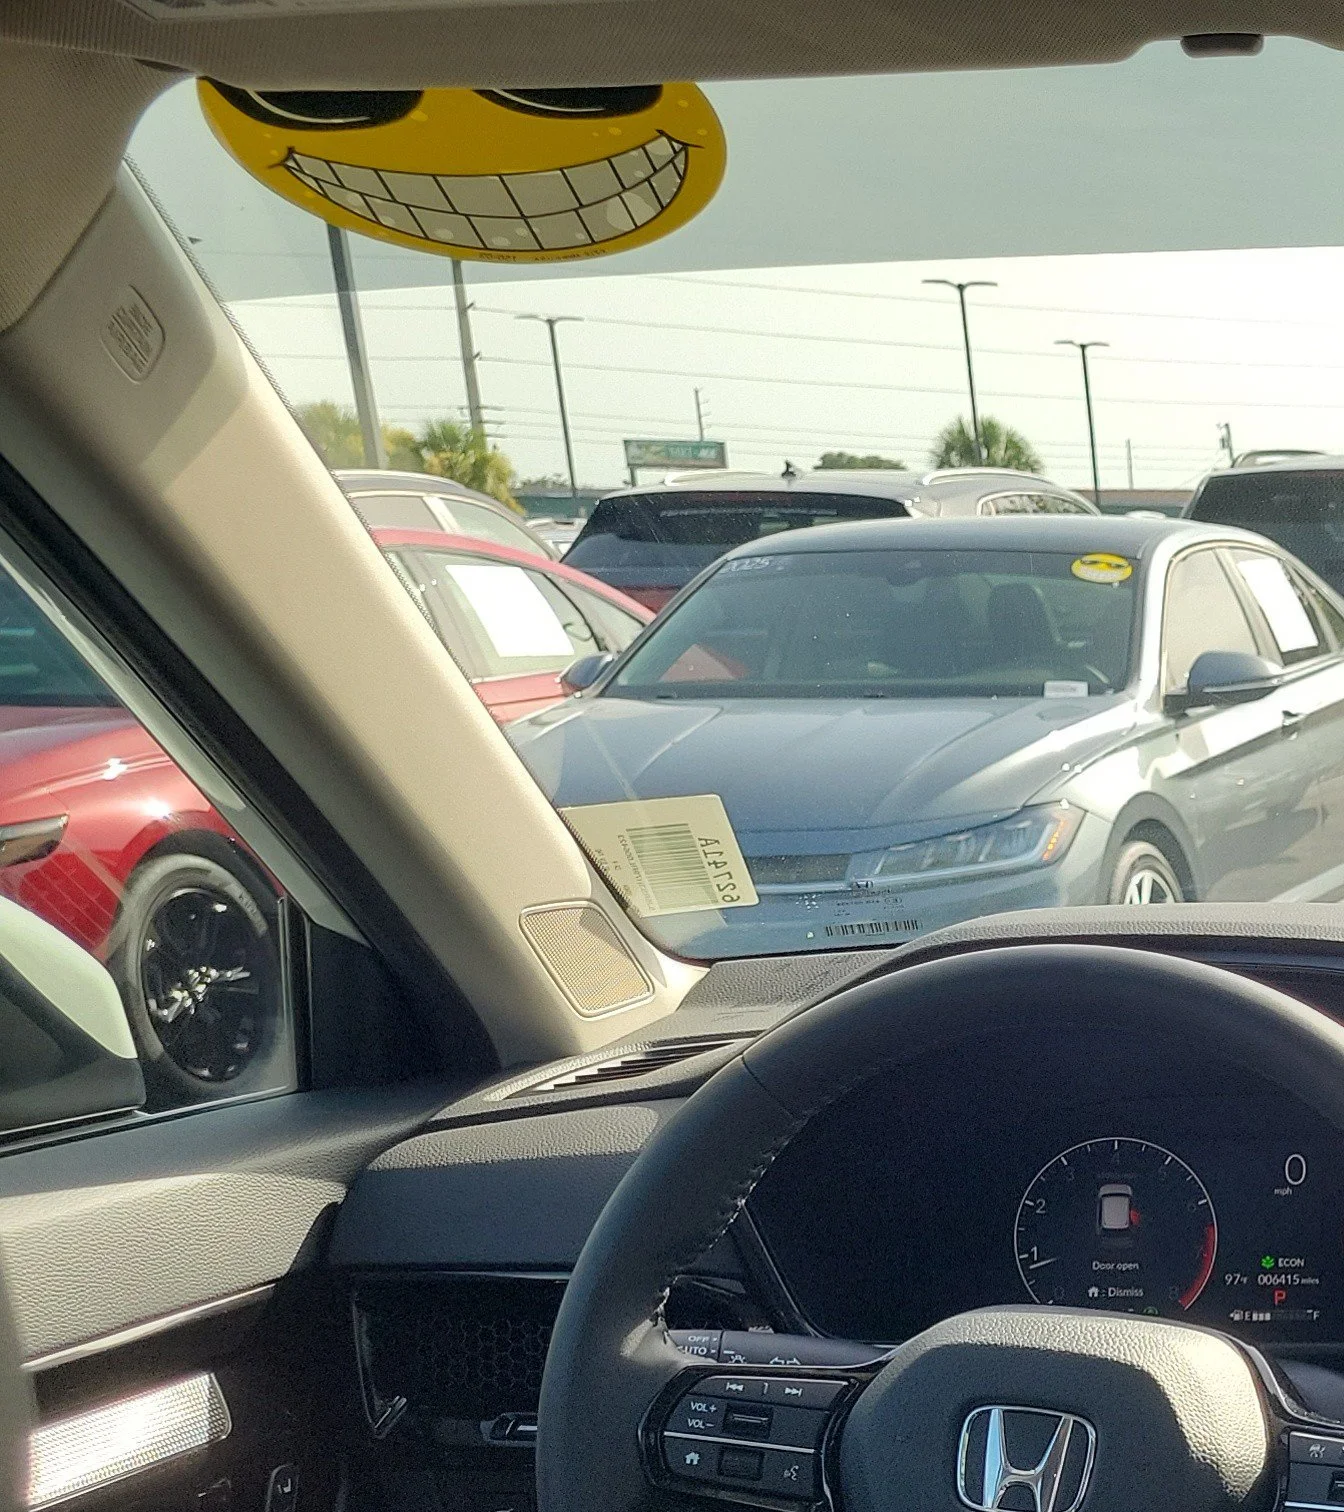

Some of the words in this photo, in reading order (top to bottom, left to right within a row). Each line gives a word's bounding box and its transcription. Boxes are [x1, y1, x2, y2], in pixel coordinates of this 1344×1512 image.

[1285, 1154, 1306, 1185] 0
[1274, 1187, 1292, 1196] mph
[1036, 1199, 1046, 1214] 2
[1030, 1246, 1038, 1261] 1
[1092, 1261, 1114, 1270] Door
[1116, 1262, 1139, 1271] open
[1278, 1258, 1304, 1267] ECON
[1258, 1274, 1300, 1285] 006415
[1108, 1287, 1143, 1297] Dismiss
[1275, 1290, 1286, 1305] P
[1313, 1311, 1320, 1320] F
